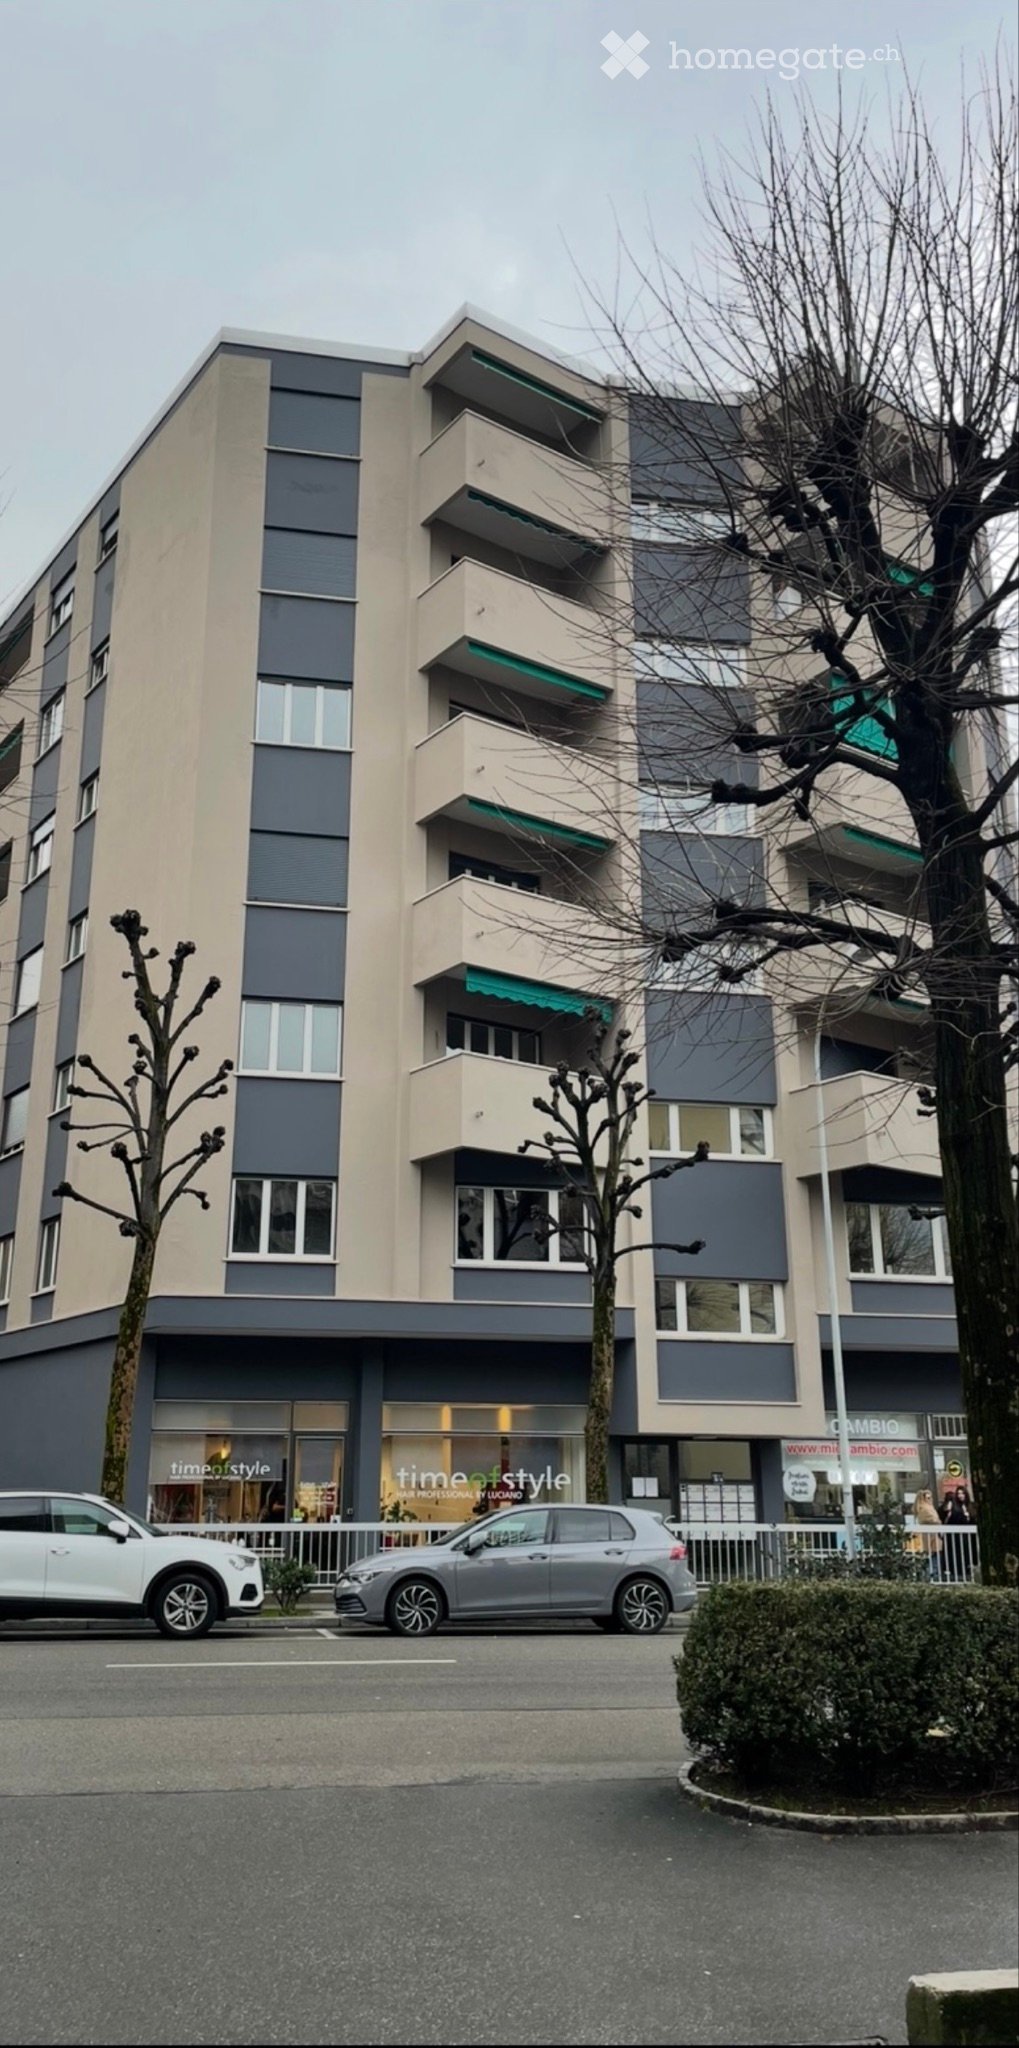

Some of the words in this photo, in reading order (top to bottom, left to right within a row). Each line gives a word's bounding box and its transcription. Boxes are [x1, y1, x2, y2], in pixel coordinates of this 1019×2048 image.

[830, 1419, 899, 1434] CAMBIO
[170, 1461, 271, 1480] timeofstyle
[396, 1465, 571, 1498] timeofstyle
[397, 1491, 415, 1499] HAIR
[417, 1491, 473, 1499] PROFESSIONAL
[487, 1491, 523, 1500] LUCIANO
